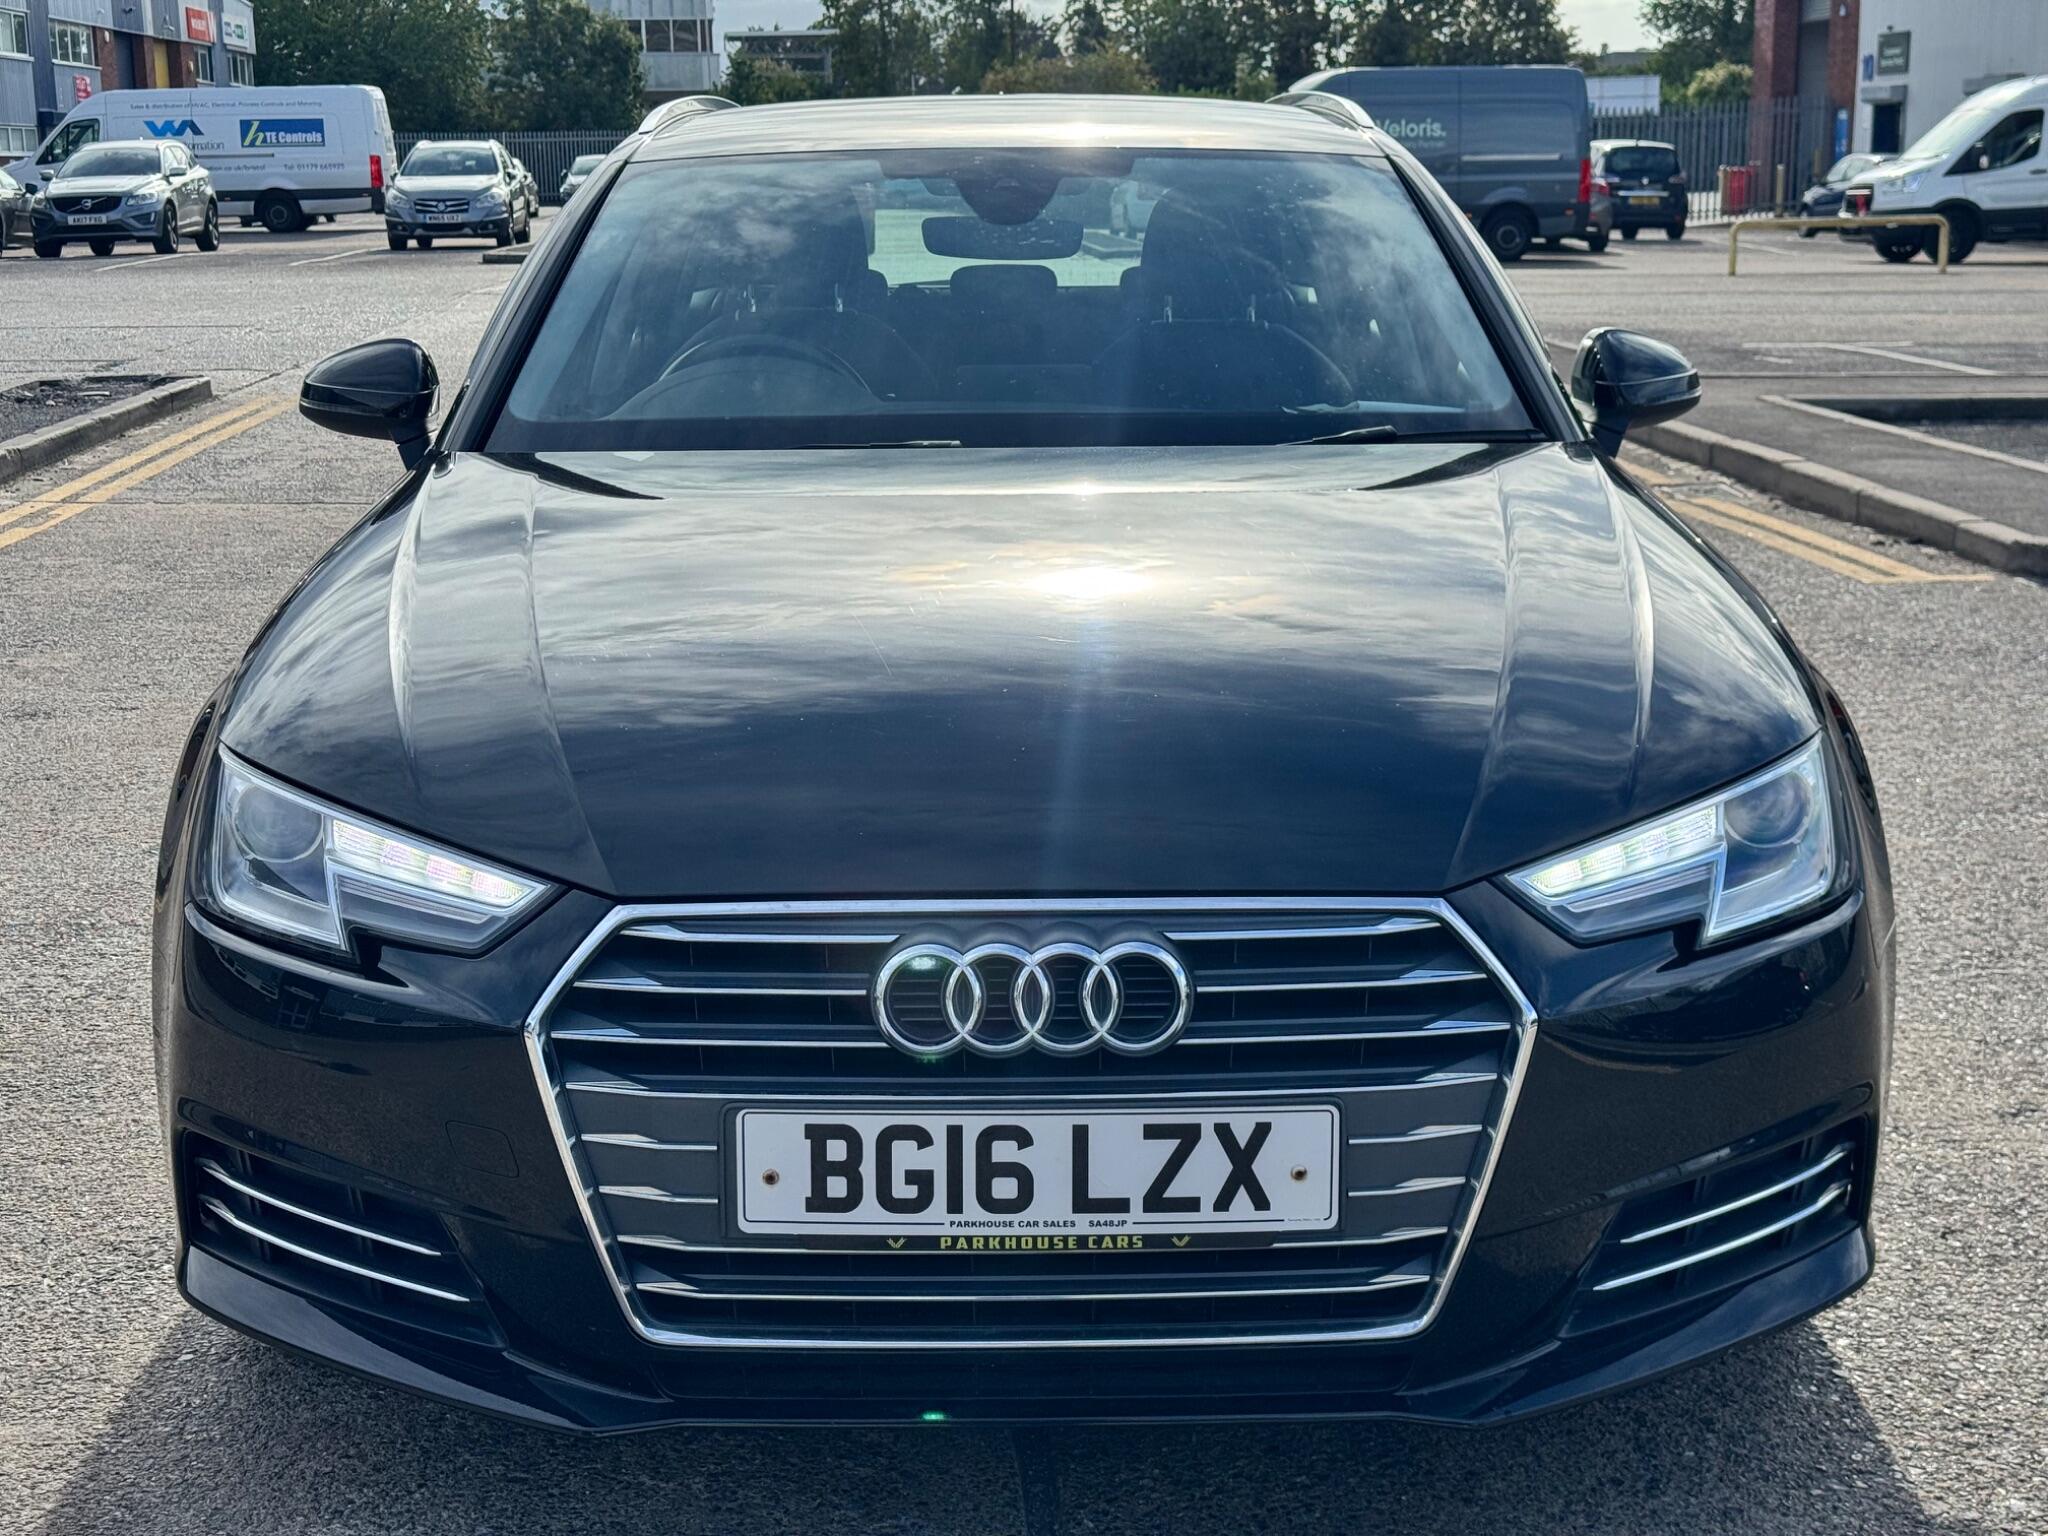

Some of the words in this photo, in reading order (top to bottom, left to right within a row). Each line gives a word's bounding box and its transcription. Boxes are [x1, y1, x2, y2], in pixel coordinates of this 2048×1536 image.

[278, 131, 322, 144] Controls
[804, 1122, 1036, 1215] BG16
[1071, 1121, 1273, 1214] LZX
[949, 1220, 1015, 1229] PARKHOUSE
[1018, 1220, 1041, 1228] CAR
[1042, 1219, 1077, 1228] SALES
[1088, 1219, 1128, 1228] SA48JP
[940, 1235, 1079, 1251] PARKHOUSE
[1087, 1234, 1145, 1249] CARS
